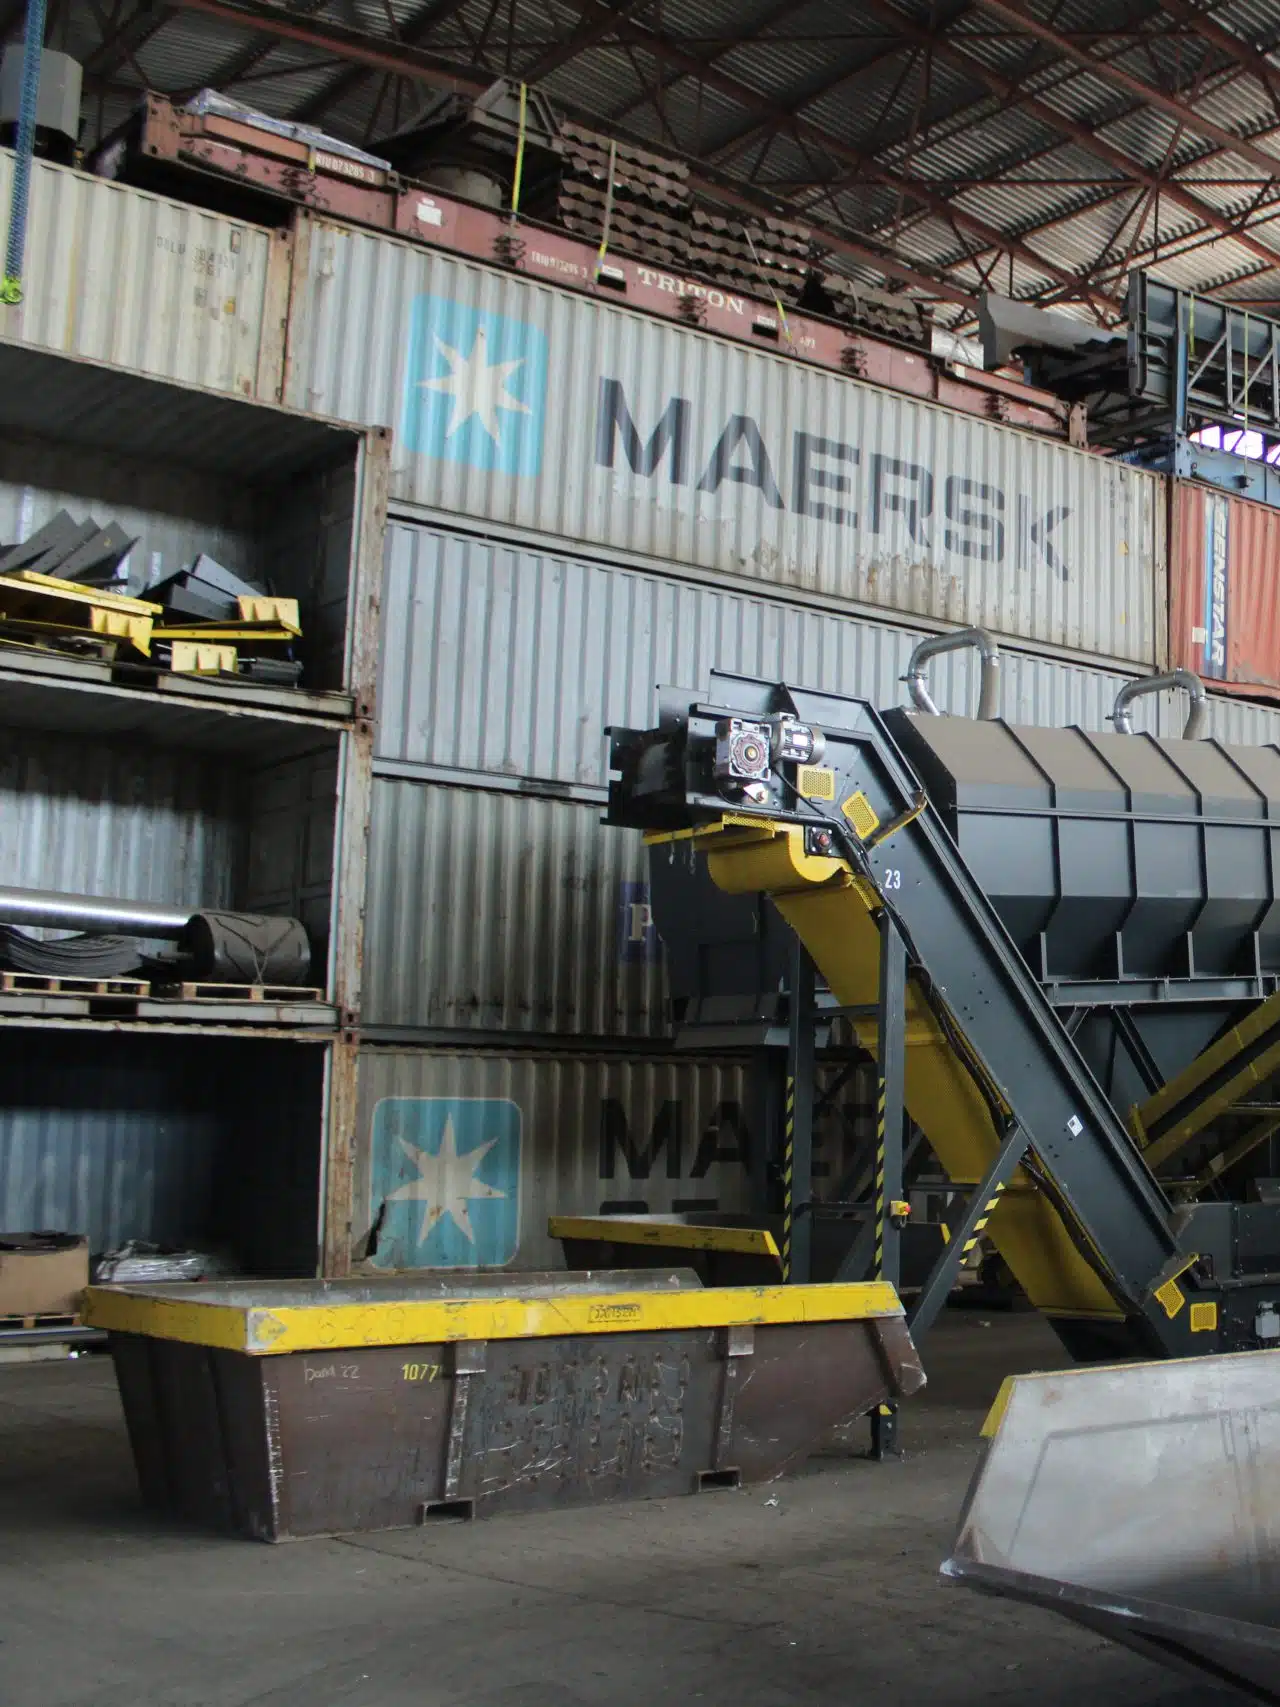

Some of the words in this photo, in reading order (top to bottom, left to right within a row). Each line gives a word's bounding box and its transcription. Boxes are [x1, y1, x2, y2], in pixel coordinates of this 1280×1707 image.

[637, 267, 745, 316] TRITON
[595, 378, 1075, 583] MAERSK
[884, 868, 901, 890] 23
[402, 1363, 440, 1384] 1077
